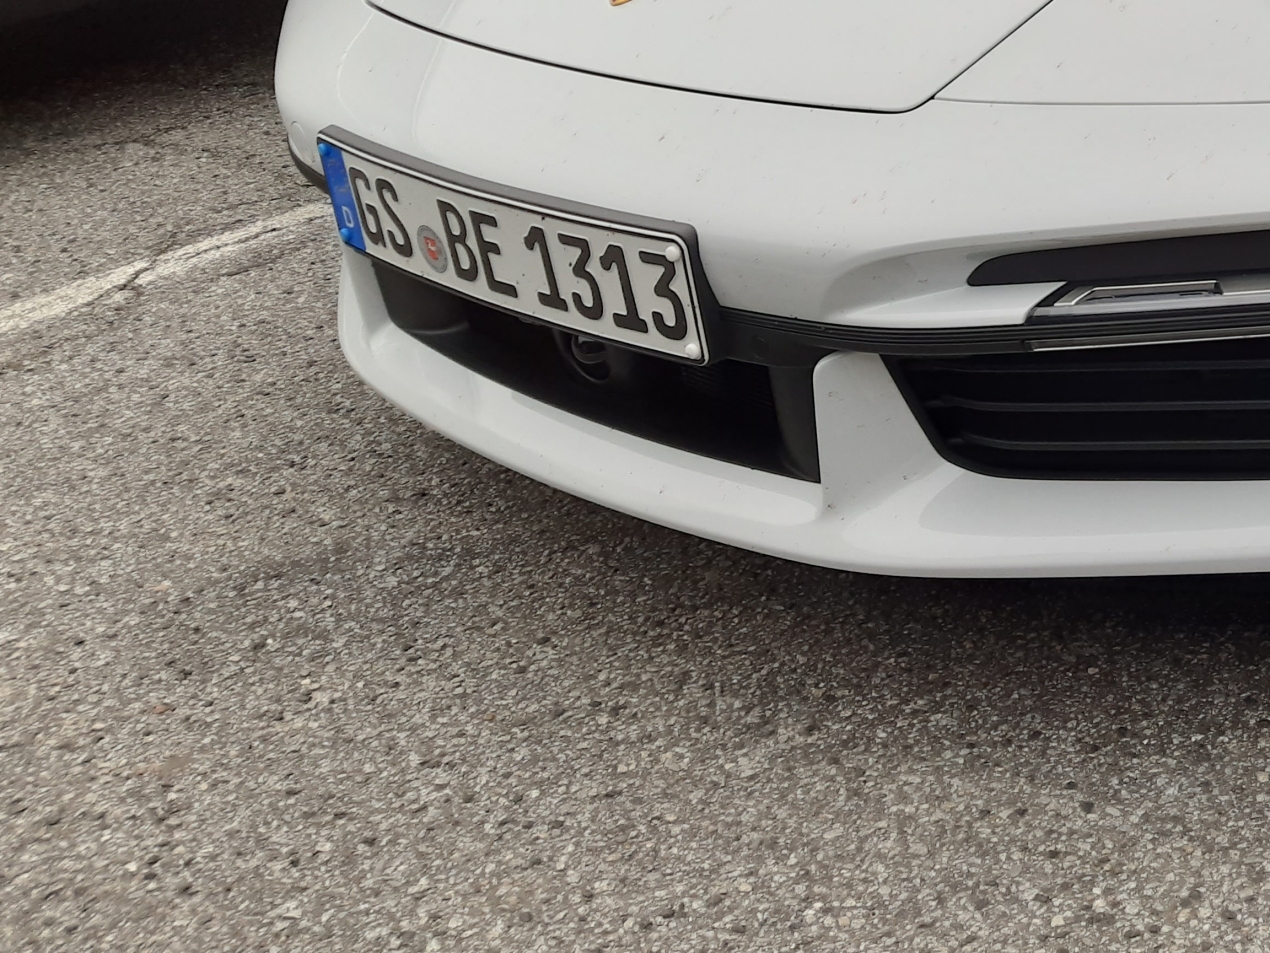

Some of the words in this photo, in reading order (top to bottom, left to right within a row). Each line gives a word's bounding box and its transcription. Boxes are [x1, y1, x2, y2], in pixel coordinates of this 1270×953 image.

[341, 205, 354, 228] D
[348, 166, 413, 258] GS
[436, 198, 518, 299] BE
[523, 224, 688, 341] 1313
